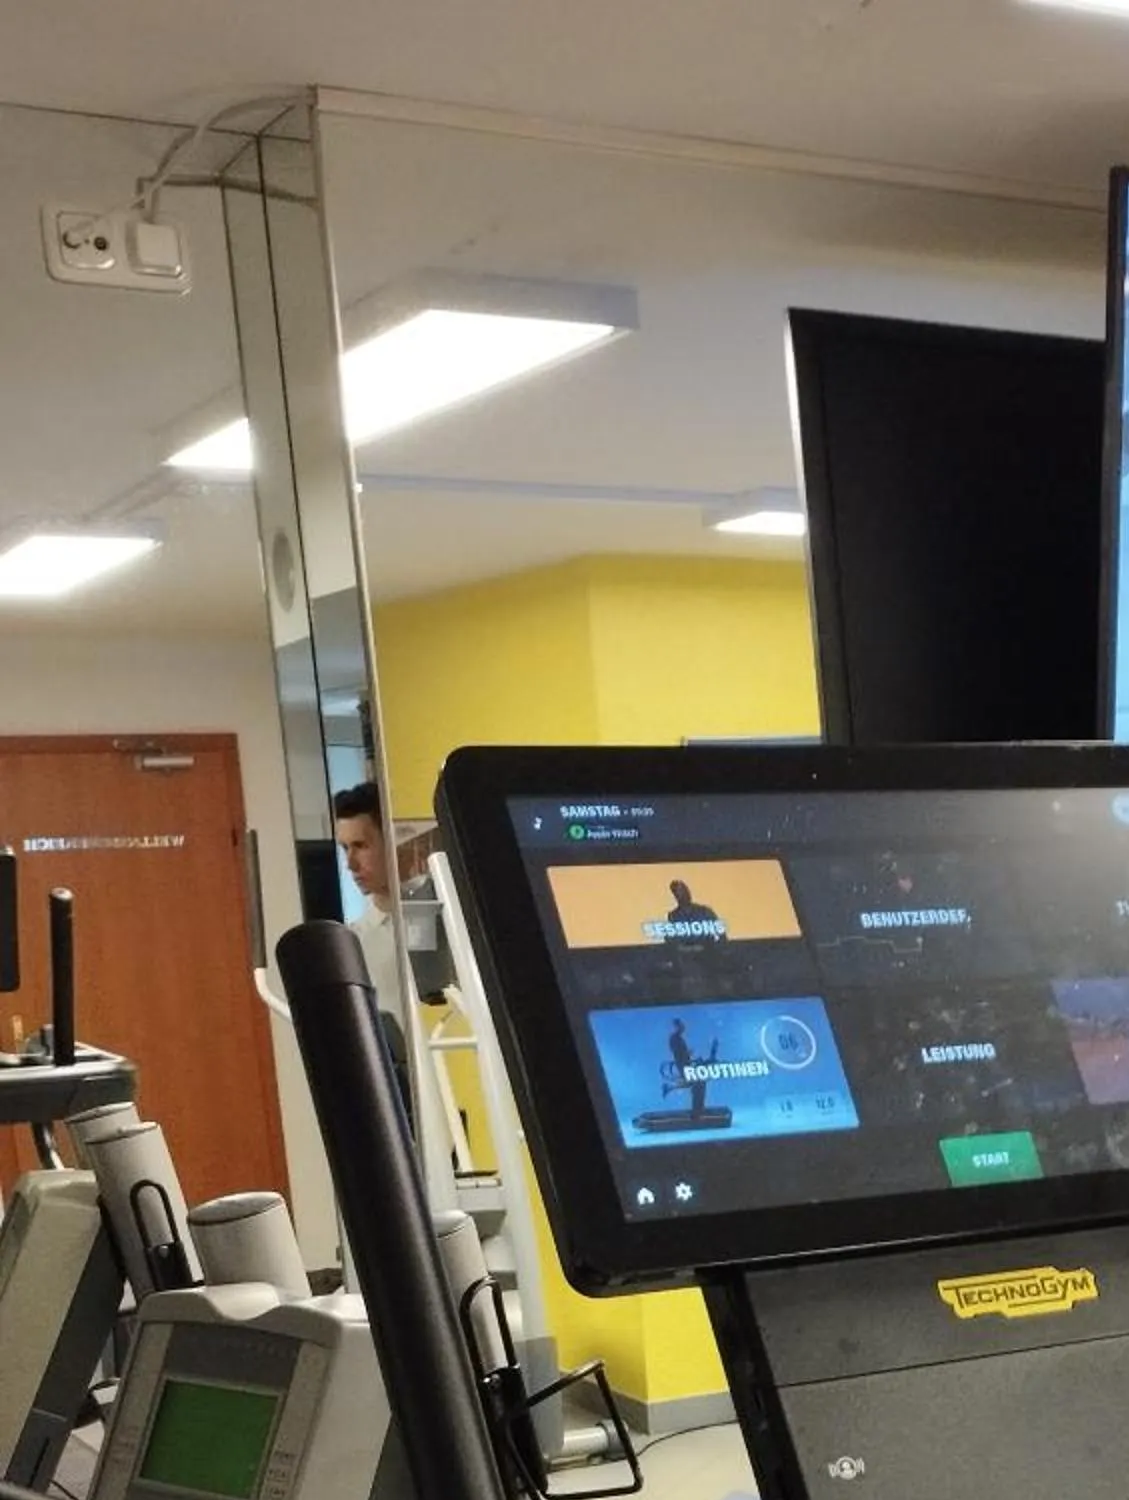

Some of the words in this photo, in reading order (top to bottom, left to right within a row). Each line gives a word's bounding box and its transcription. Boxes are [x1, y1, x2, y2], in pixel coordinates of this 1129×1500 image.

[560, 806, 620, 818] SAMSTAG
[643, 919, 726, 938] SESSIONS
[921, 1042, 997, 1064] LEISTUNG
[683, 1059, 770, 1083] ROUTINEN
[971, 1151, 1010, 1168] START
[942, 1275, 1092, 1309] TECHNOGYM
